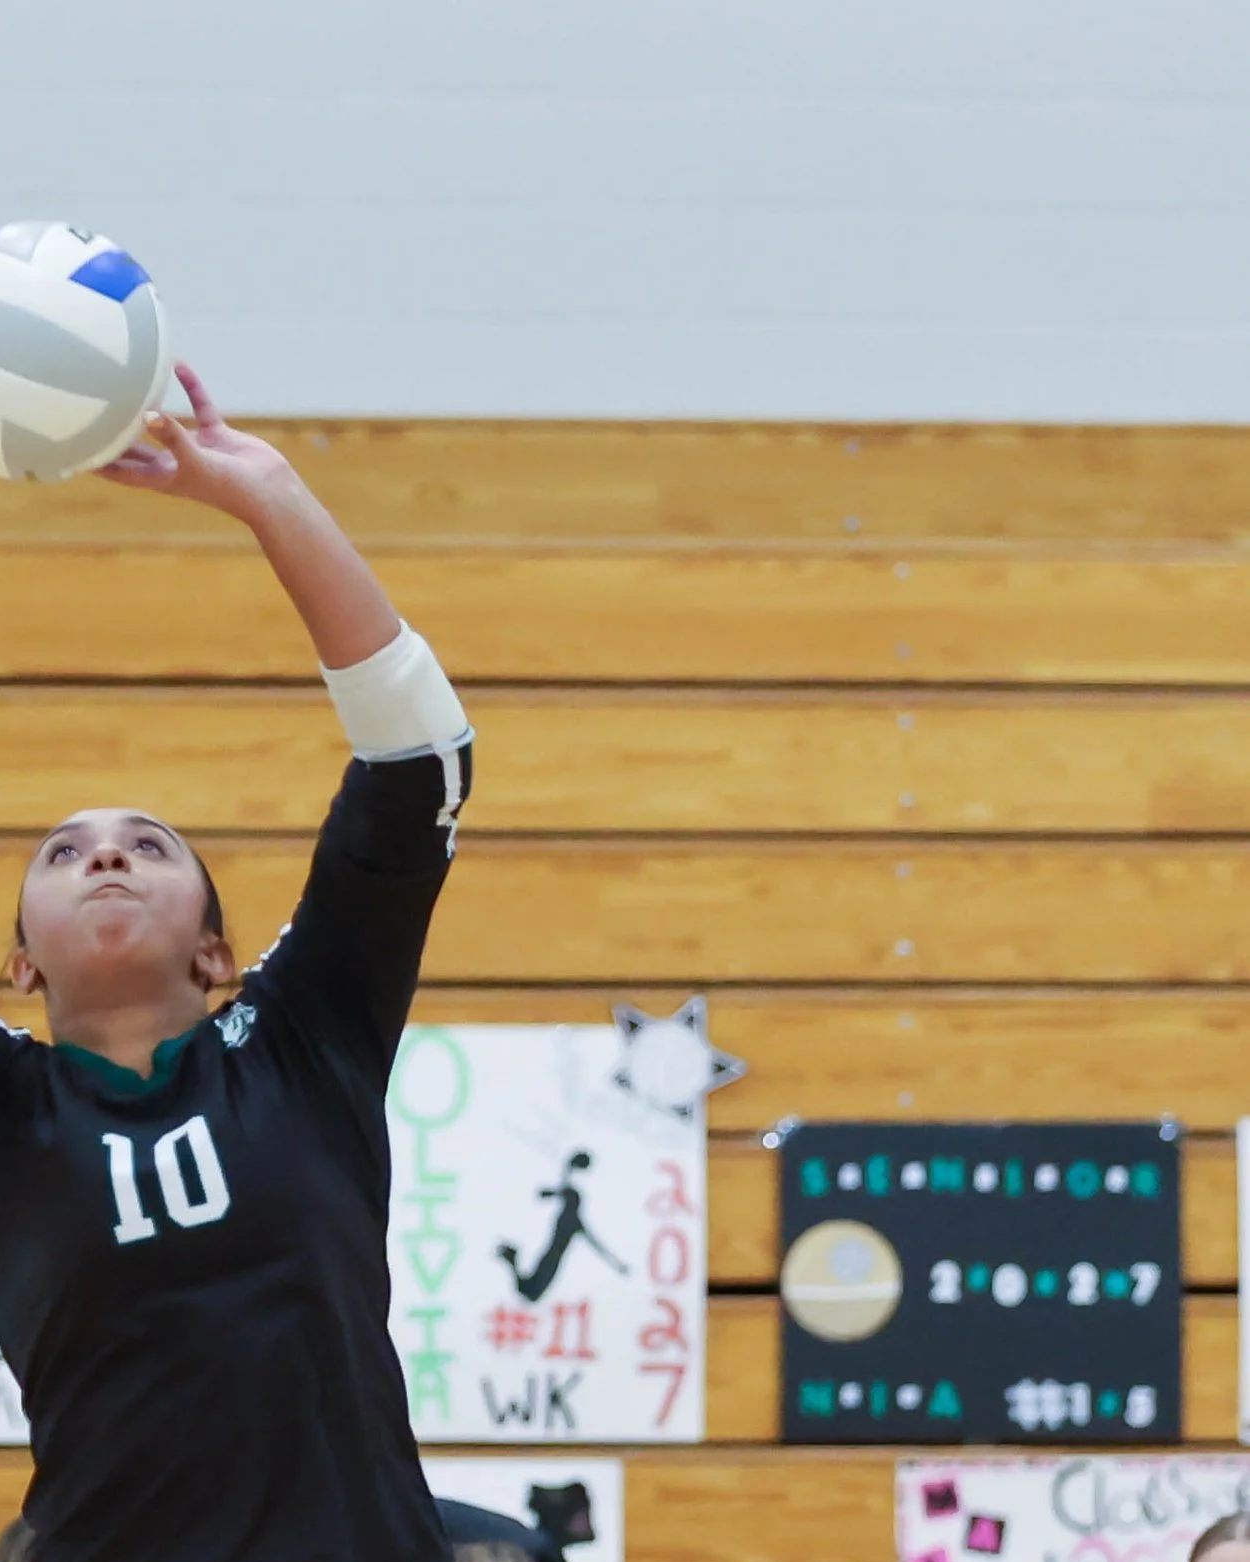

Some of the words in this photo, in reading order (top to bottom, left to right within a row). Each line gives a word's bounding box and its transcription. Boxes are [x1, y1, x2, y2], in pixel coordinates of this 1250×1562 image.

[101, 1114, 231, 1245] 10
[484, 1302, 597, 1361] #11
[640, 1160, 693, 1428] 2027
[480, 1371, 584, 1431] WK
